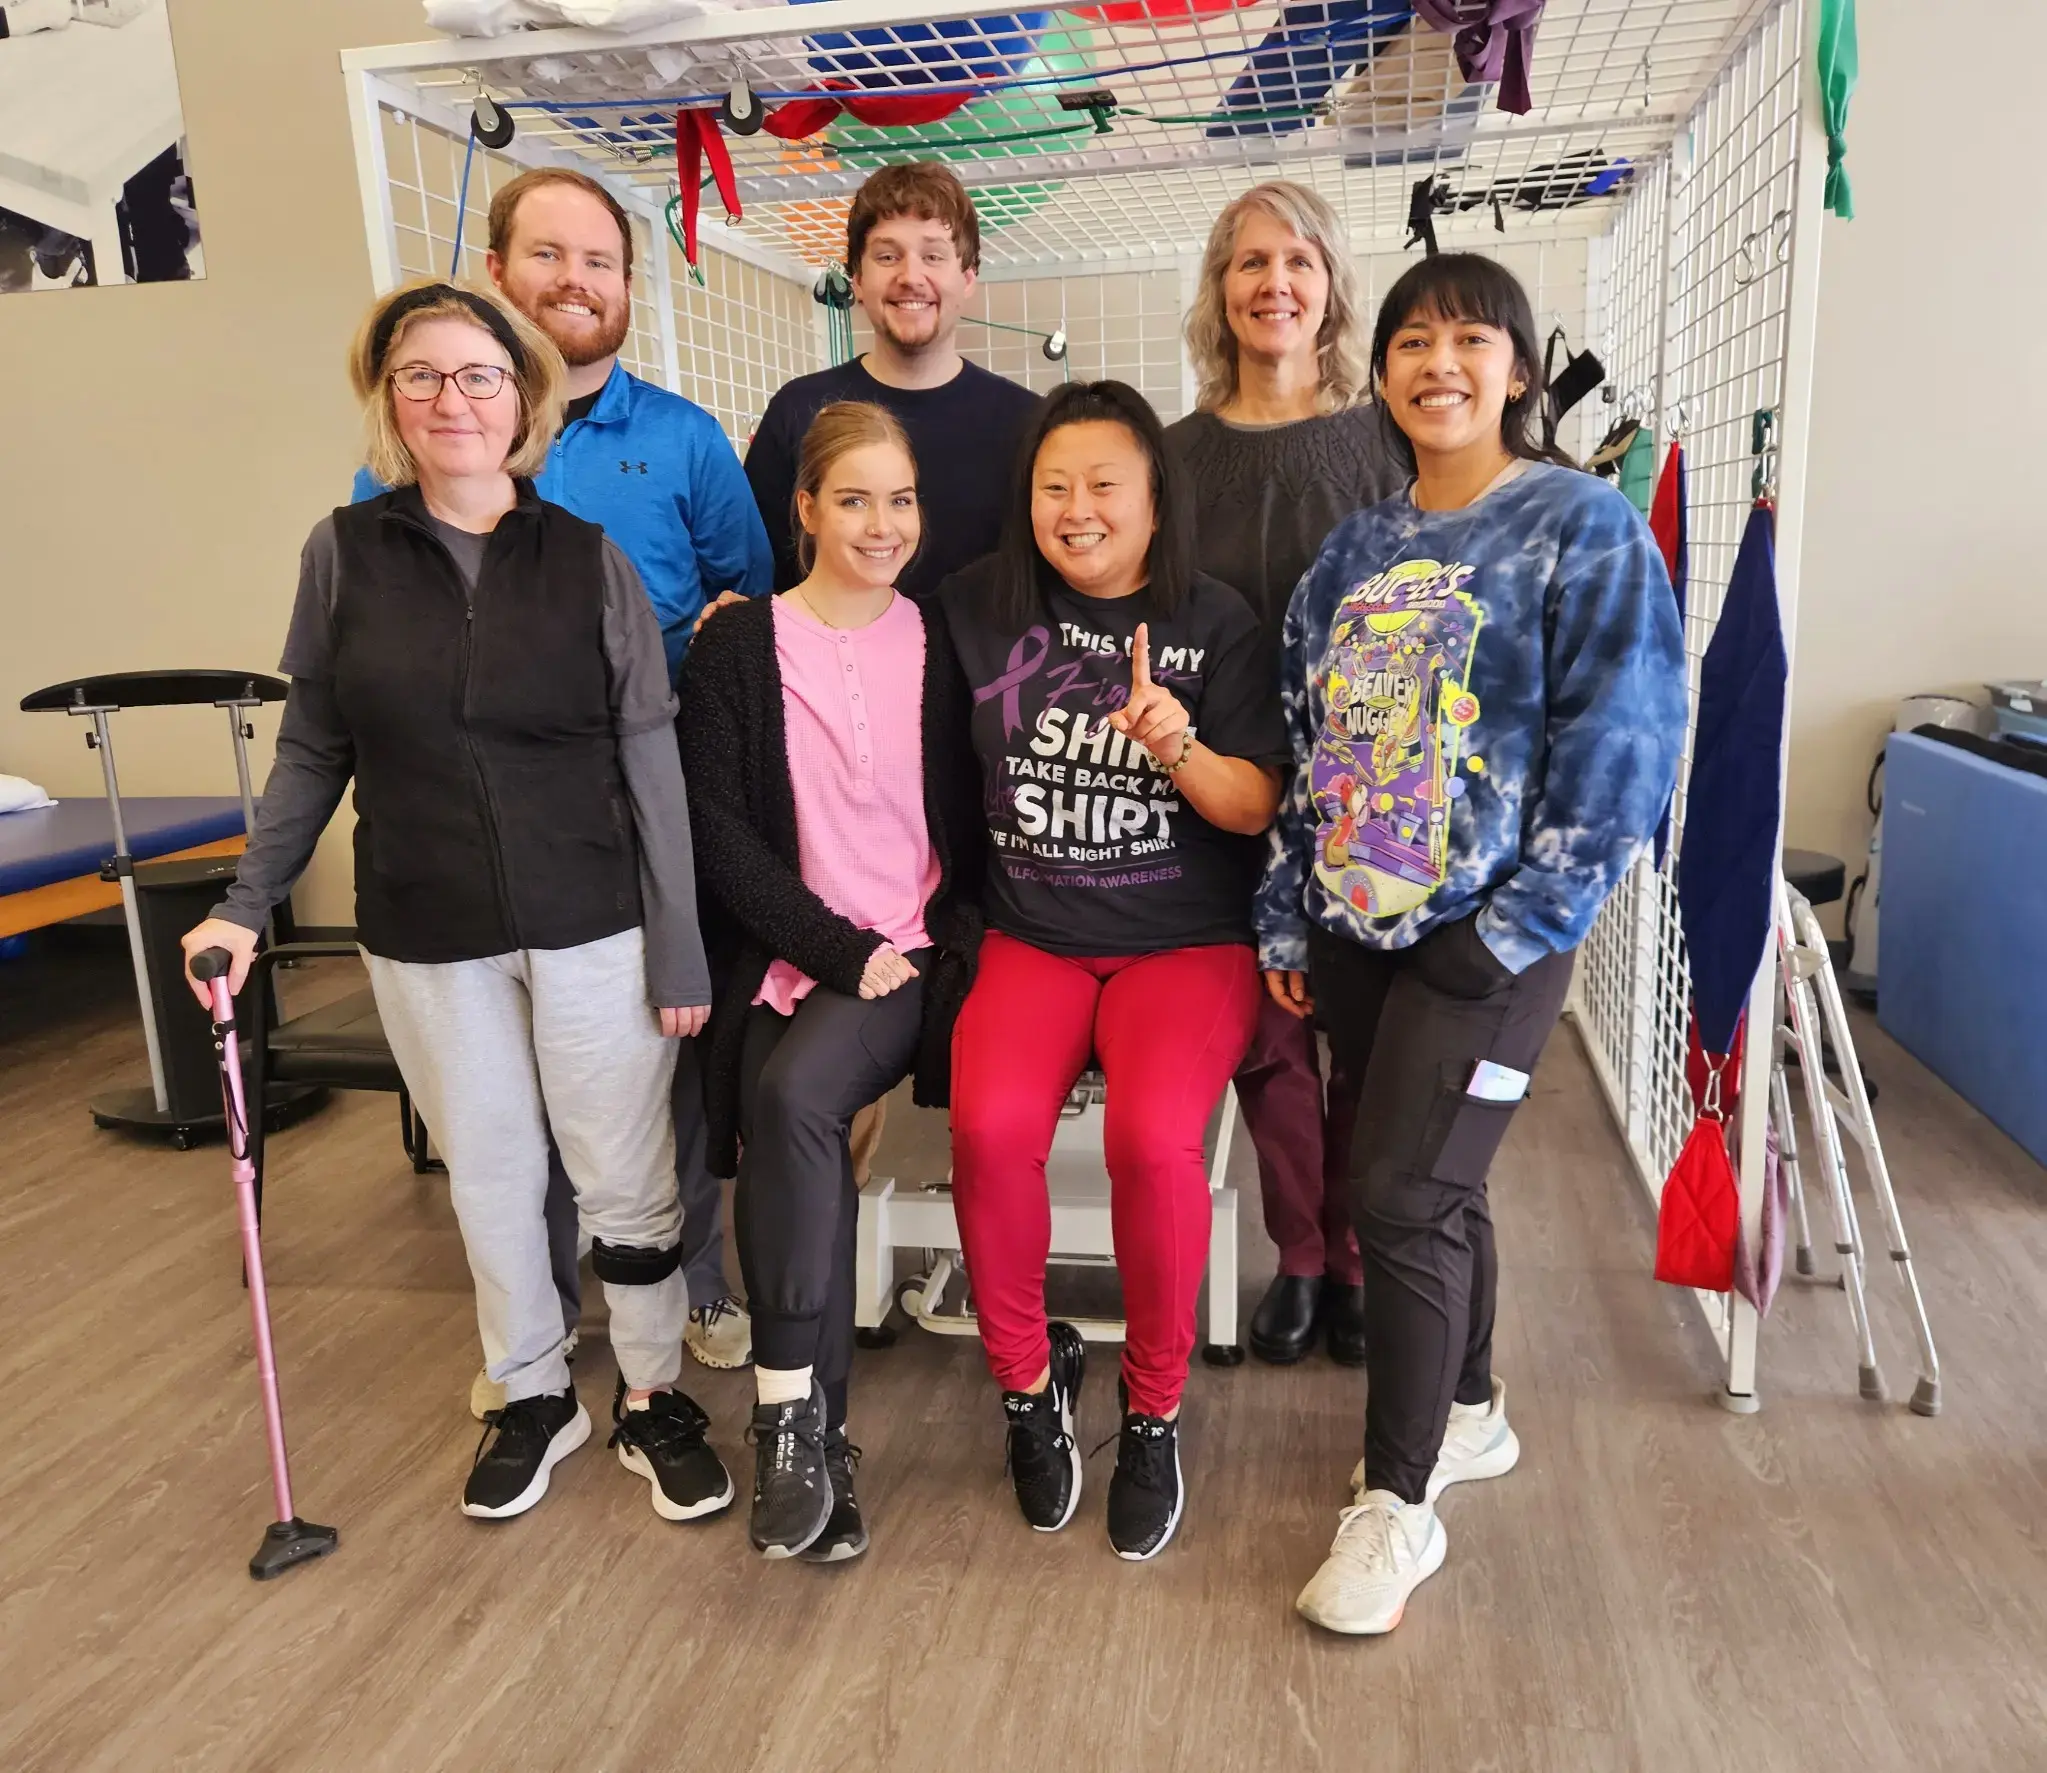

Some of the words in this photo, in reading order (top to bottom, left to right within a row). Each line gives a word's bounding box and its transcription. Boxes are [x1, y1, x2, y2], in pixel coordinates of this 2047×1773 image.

[1350, 561, 1476, 604] BUC-EE'S
[1059, 622, 1117, 655] THIS
[1159, 645, 1205, 672] MY
[1350, 672, 1416, 708] BEAVER
[1029, 707, 1197, 773] SHIR
[1006, 756, 1066, 784] TAKE
[1074, 768, 1143, 796] BACK
[1014, 783, 1179, 843] SHIRT
[1011, 834, 1030, 851] I'M
[1033, 843, 1064, 858] ALL
[1068, 845, 1124, 861] RIGHT
[1099, 865, 1183, 889] AWARENESS
